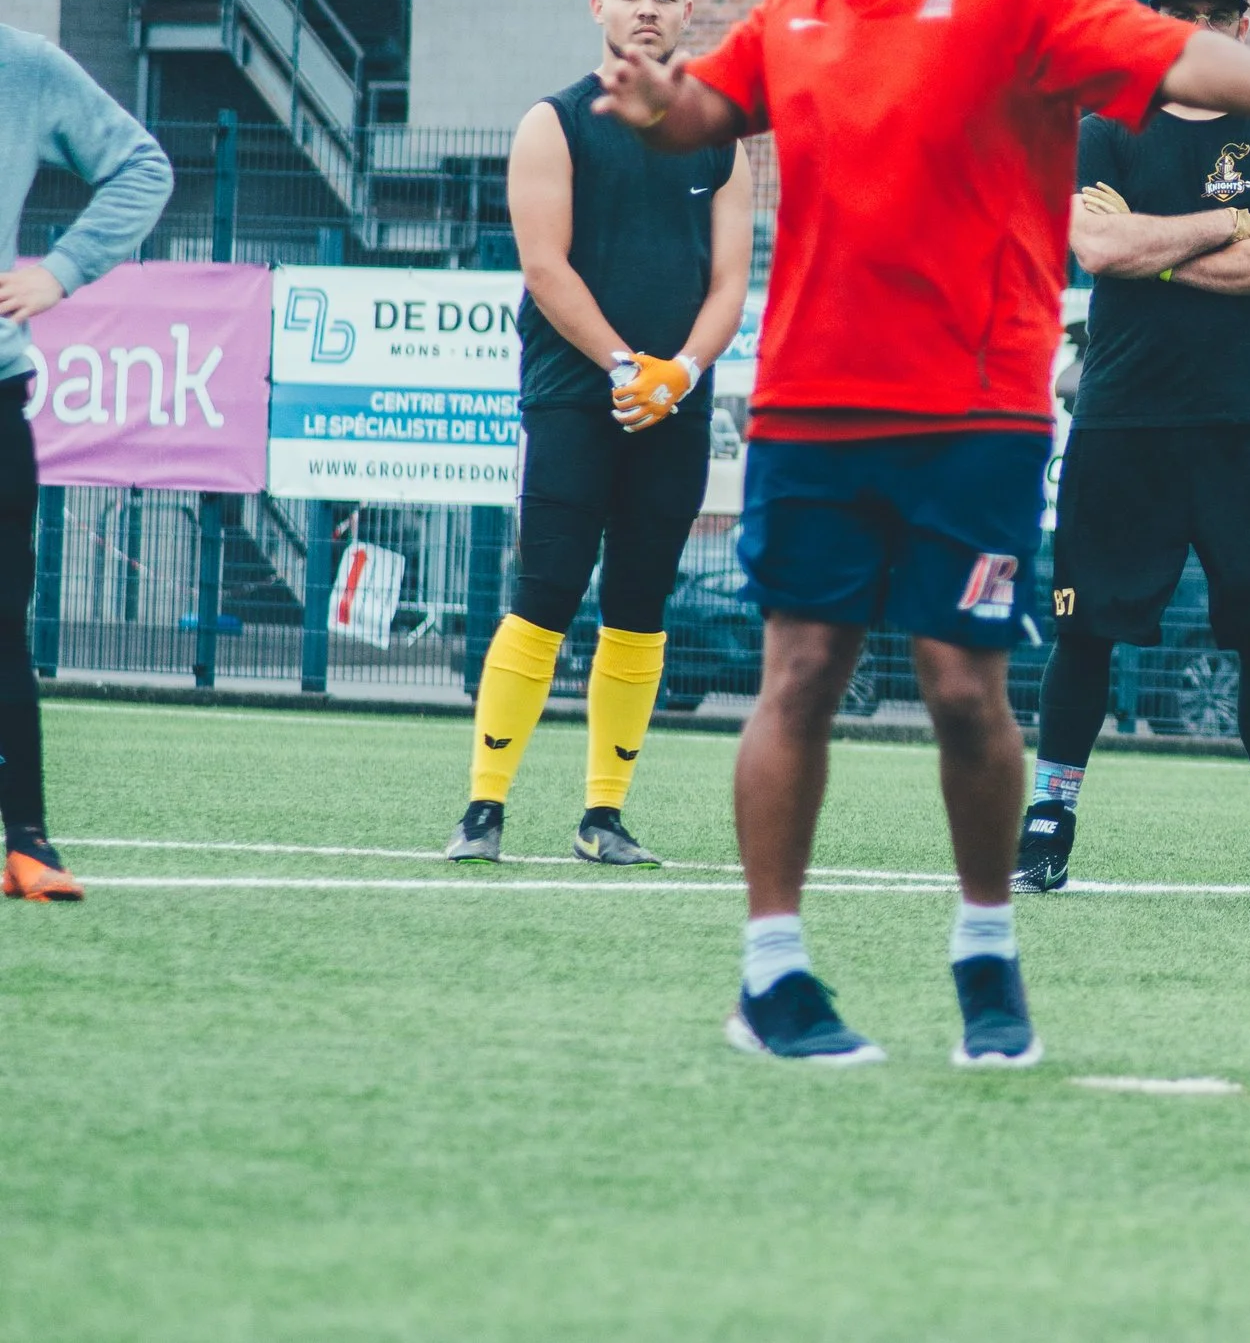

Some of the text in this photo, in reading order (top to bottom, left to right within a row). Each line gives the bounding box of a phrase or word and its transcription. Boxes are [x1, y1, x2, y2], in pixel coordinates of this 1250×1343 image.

[1207, 181, 1243, 194] KNIGHTS
[374, 300, 426, 332] DE
[390, 343, 440, 357] MONS
[465, 344, 510, 358] LENS
[370, 390, 446, 414] CENTRE
[304, 414, 327, 437] LE
[329, 412, 448, 441] SPÉCIALISTE
[452, 420, 476, 442] DE
[1028, 819, 1058, 834] NIKE
